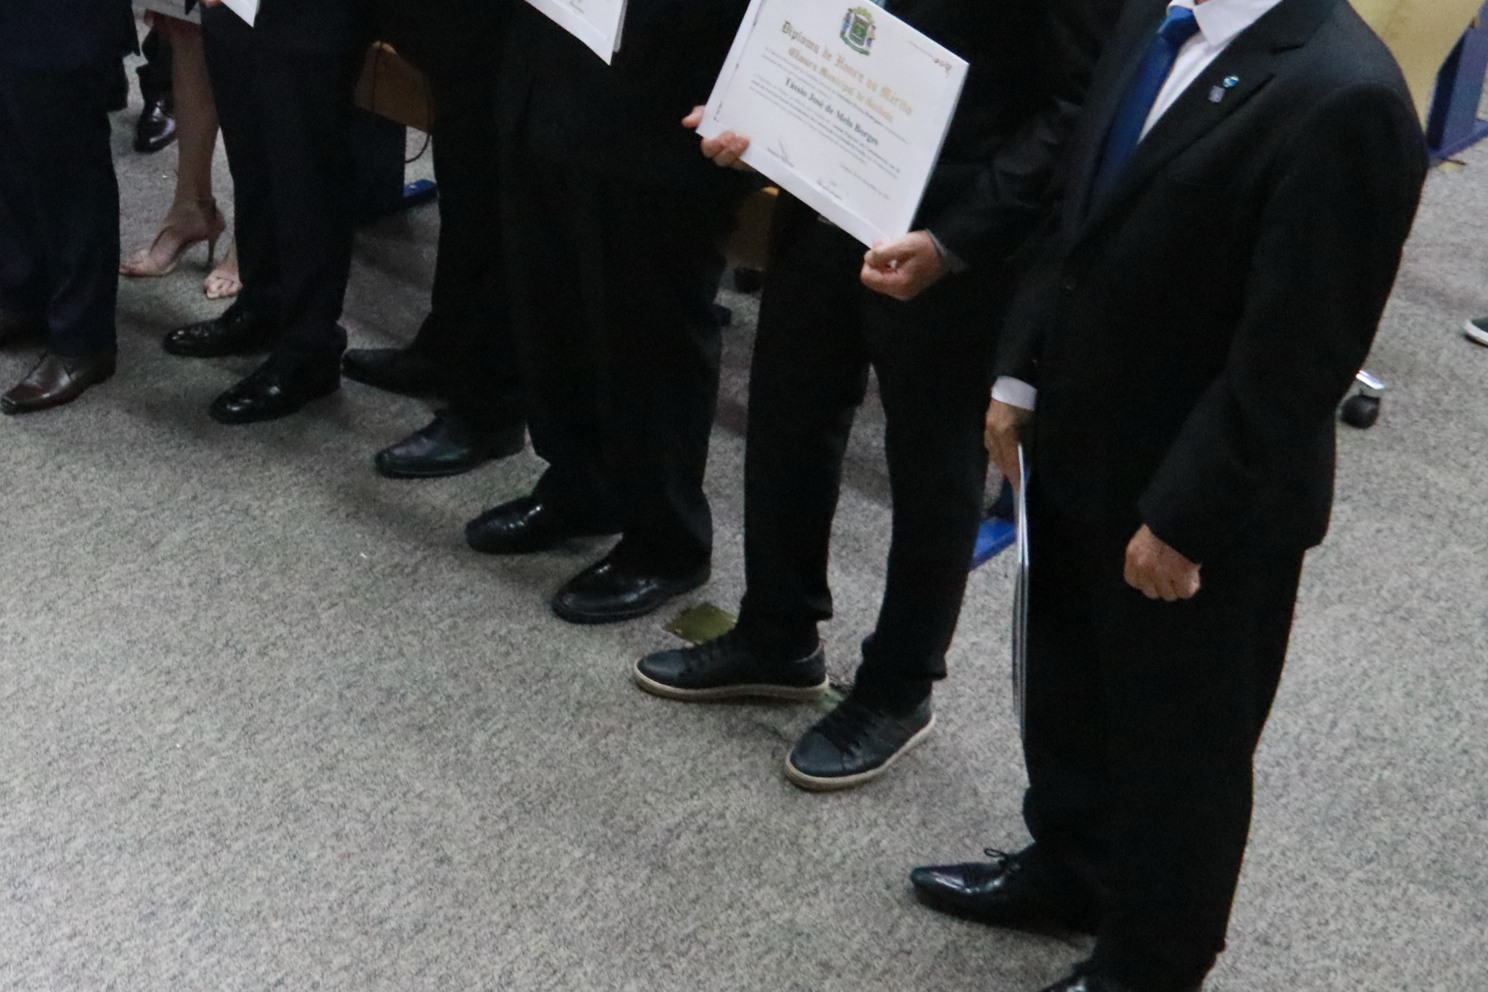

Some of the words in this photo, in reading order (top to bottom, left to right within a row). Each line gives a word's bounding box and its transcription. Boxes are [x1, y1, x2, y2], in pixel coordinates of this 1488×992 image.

[781, 20, 820, 54] Diploma
[821, 46, 832, 61] de
[834, 54, 864, 83] Honra
[825, 105, 834, 115] de
[836, 110, 854, 128] Melo
[854, 122, 879, 146] Borges
